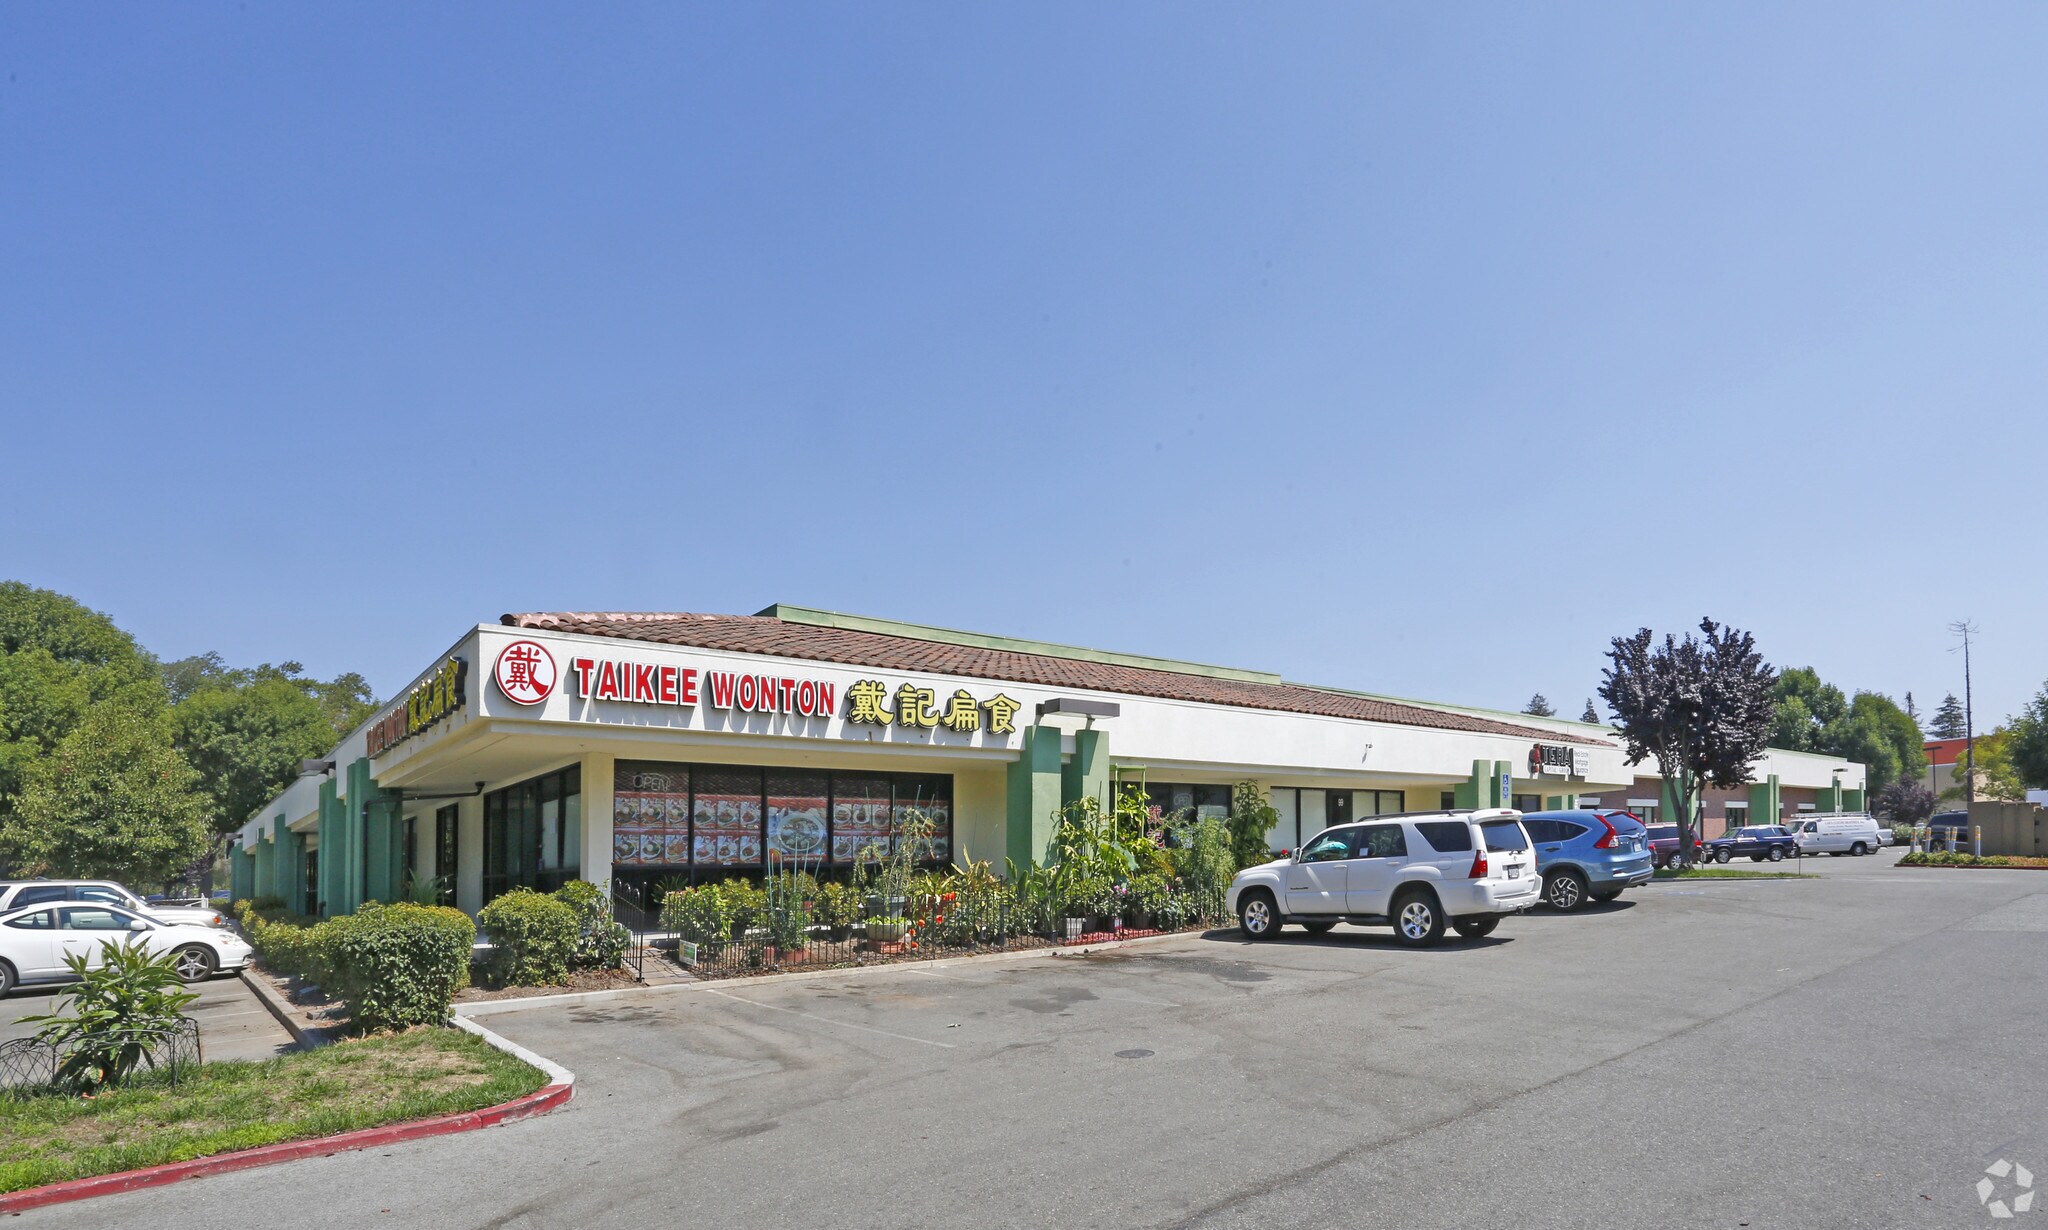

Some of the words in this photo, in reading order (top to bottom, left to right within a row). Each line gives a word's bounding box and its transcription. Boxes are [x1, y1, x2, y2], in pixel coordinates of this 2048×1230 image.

[504, 645, 549, 696] 戴
[574, 657, 699, 706] TAIKEE
[710, 671, 836, 717] WONTON
[849, 680, 1021, 734] 戴記扁食
[1542, 746, 1571, 766] TERA
[633, 775, 668, 792] OPEN
